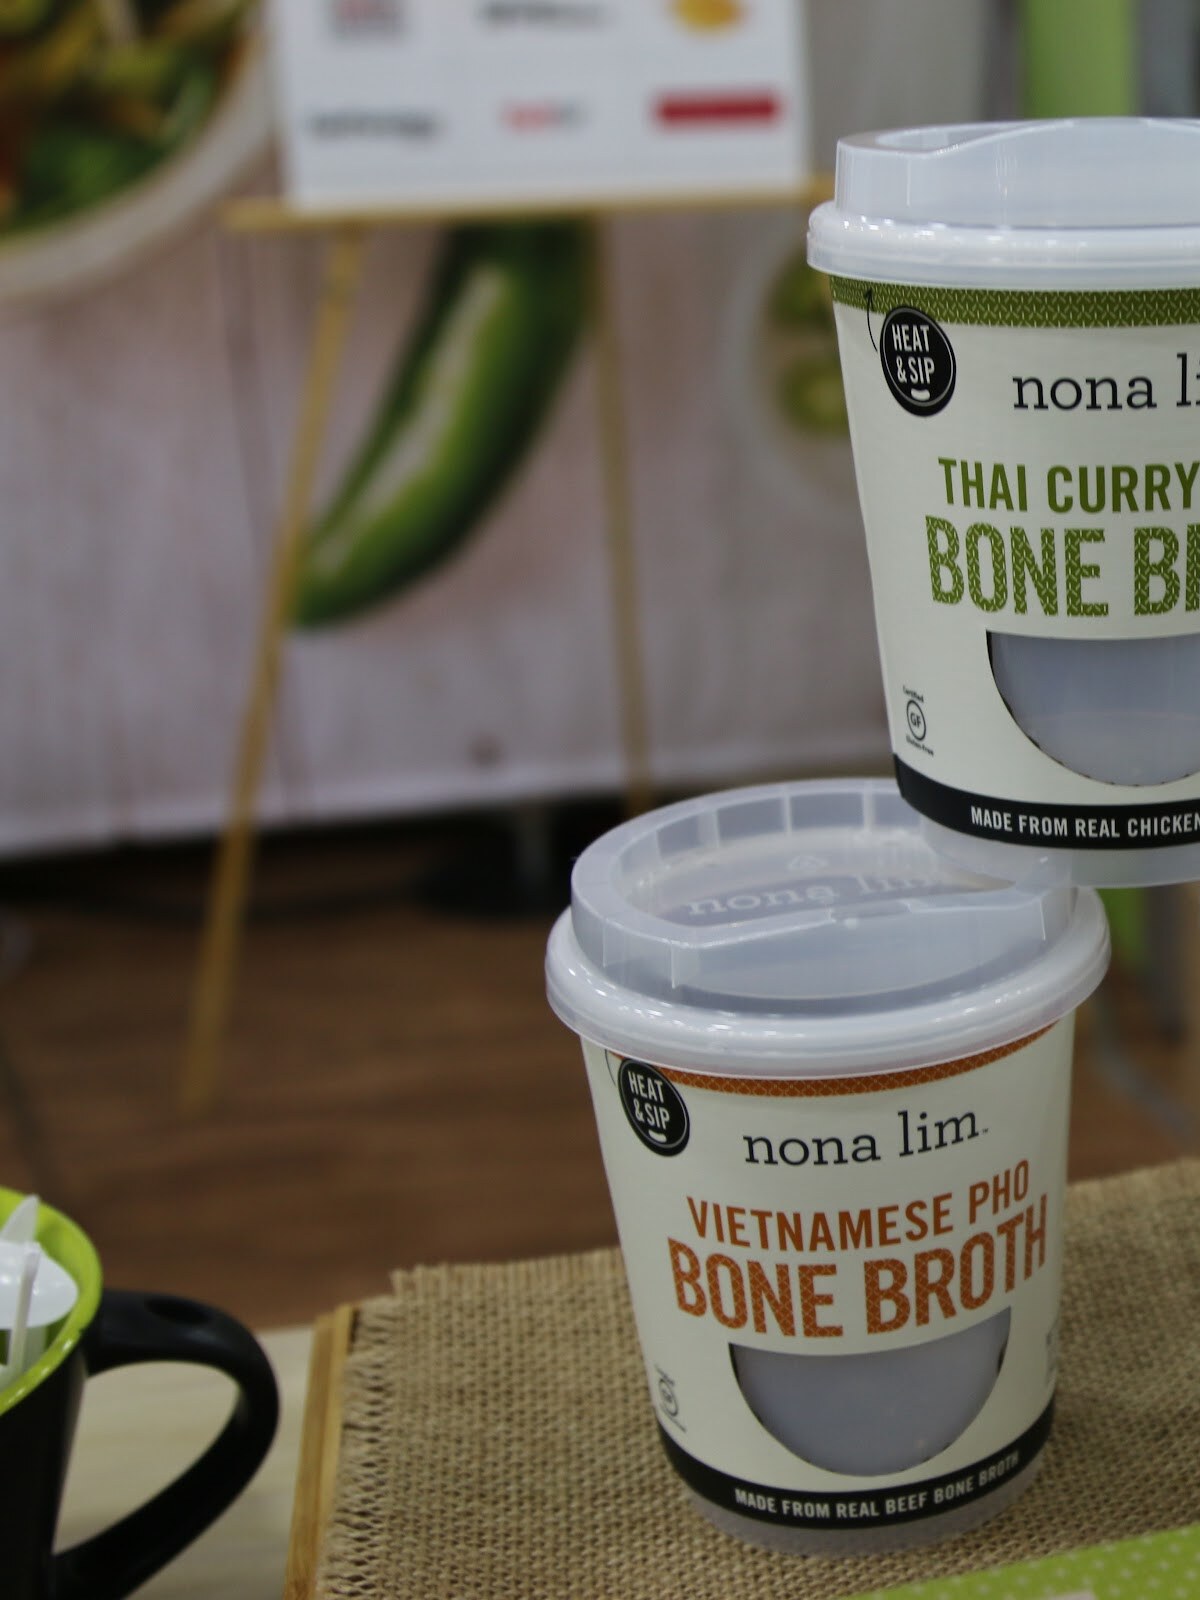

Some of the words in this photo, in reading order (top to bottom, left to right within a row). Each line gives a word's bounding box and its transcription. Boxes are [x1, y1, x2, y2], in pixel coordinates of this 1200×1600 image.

[891, 324, 930, 352] HEAT
[896, 354, 908, 384] &
[908, 356, 935, 384] SIP
[1013, 374, 1154, 412] nona
[938, 456, 1029, 512] THAI
[1046, 459, 1200, 514] CURRY
[925, 514, 1109, 617] BONE
[970, 805, 1013, 832] MADE
[1018, 814, 1069, 837] FROM
[1075, 817, 1121, 838] REAL
[627, 1070, 665, 1104] HEAT
[633, 1098, 645, 1123] &
[644, 1102, 670, 1130] SIP
[743, 1131, 881, 1168] nona
[897, 1109, 980, 1158] lim
[687, 1192, 953, 1252] VIETNAMESE
[969, 1159, 1029, 1225] PHO
[668, 1236, 844, 1338] BONE
[863, 1193, 1048, 1335] BROTH
[734, 1487, 777, 1515] MADE
[782, 1500, 831, 1519] FROM
[836, 1501, 880, 1518] REAL
[885, 1491, 929, 1516] BEEF
[934, 1476, 976, 1505] BONE
[979, 1449, 1020, 1487] BROTH
